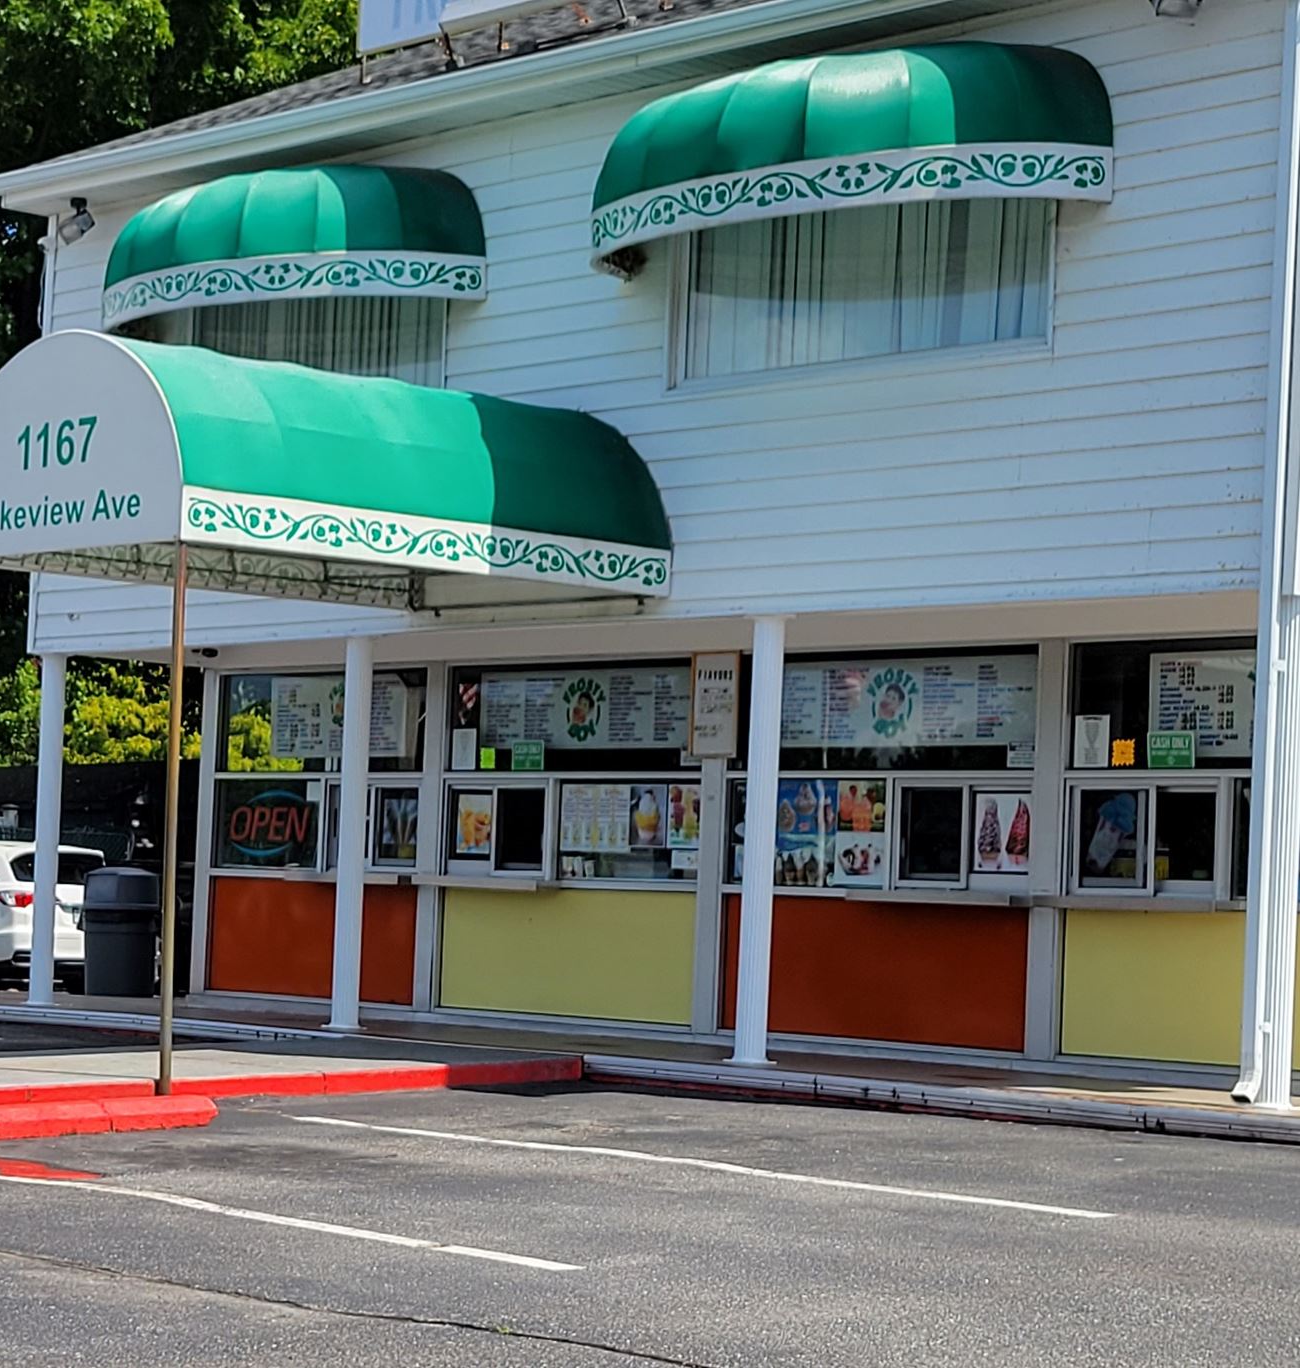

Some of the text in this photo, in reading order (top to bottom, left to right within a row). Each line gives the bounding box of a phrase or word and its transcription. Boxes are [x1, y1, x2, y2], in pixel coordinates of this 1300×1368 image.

[17, 415, 98, 471] 1167
[91, 488, 141, 521] Ave
[1150, 736, 1171, 749] CASH
[1171, 735, 1190, 748] ONLY
[230, 806, 310, 842] OPEN
